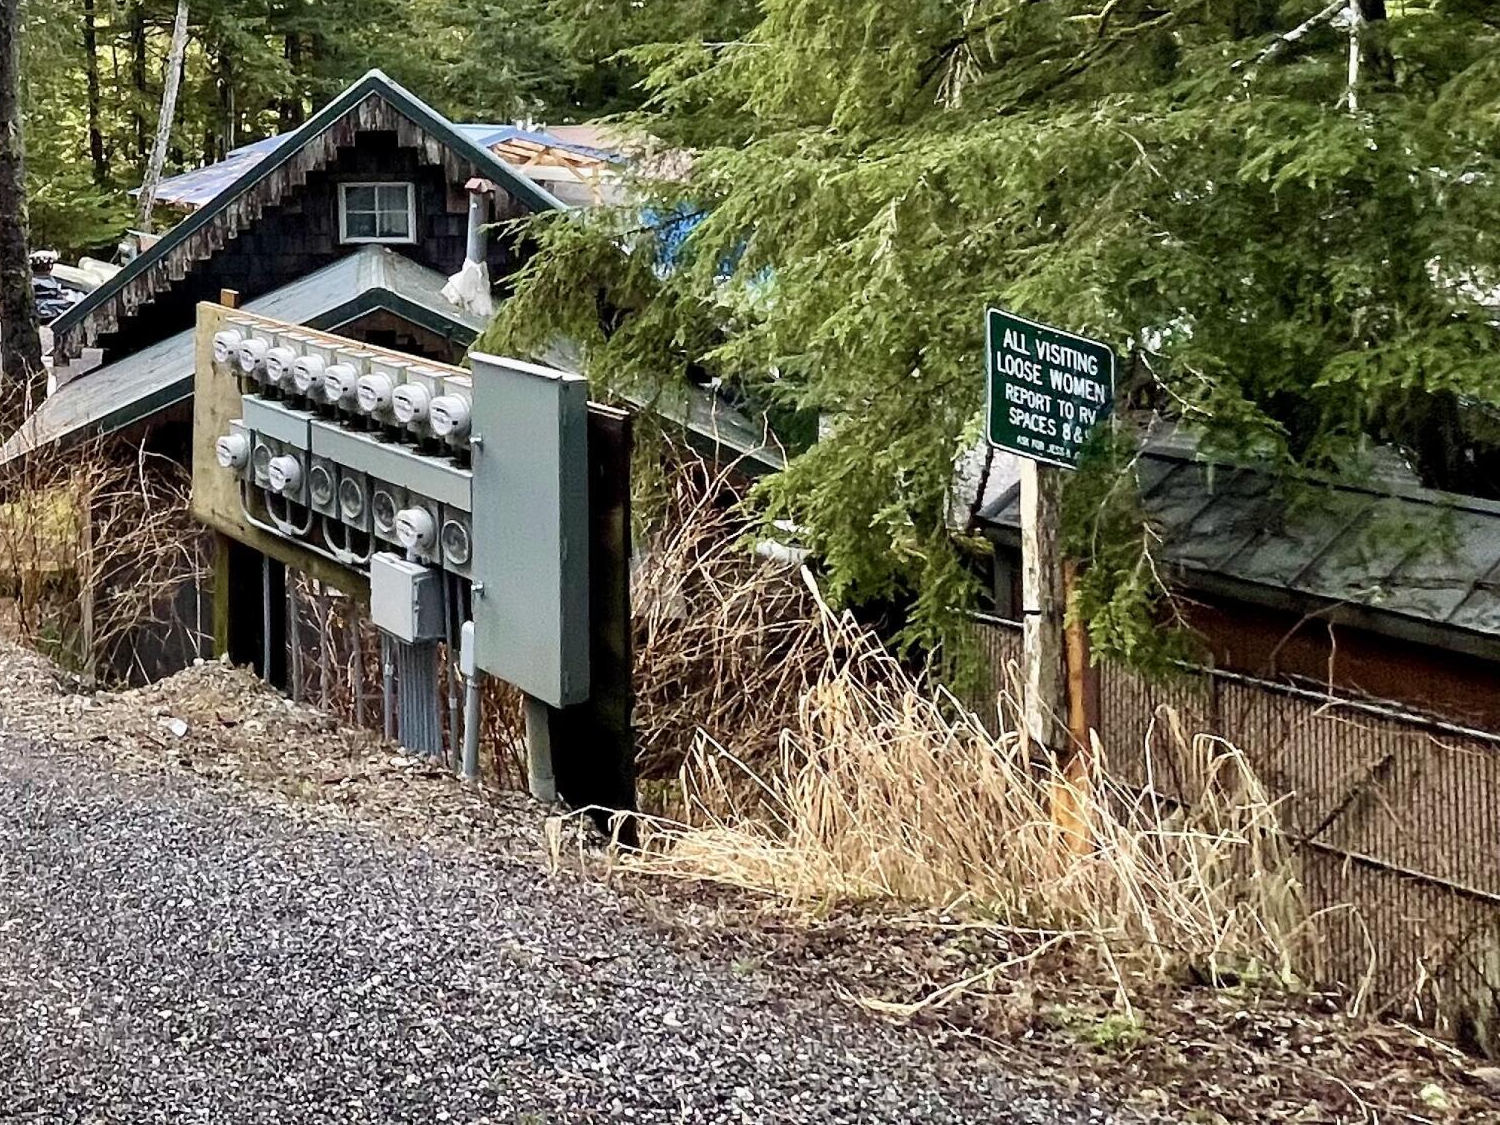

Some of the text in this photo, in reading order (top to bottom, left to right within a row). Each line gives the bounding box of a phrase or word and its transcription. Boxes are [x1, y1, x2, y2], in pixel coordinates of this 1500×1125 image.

[1003, 328, 1098, 376] ALL VISITING
[997, 351, 1106, 404] LOOSE WOMEN
[1005, 382, 1097, 426] REPORT TO RV
[1008, 406, 1057, 436] SPACES
[1062, 422, 1072, 441] 8
[1073, 425, 1084, 444] &
